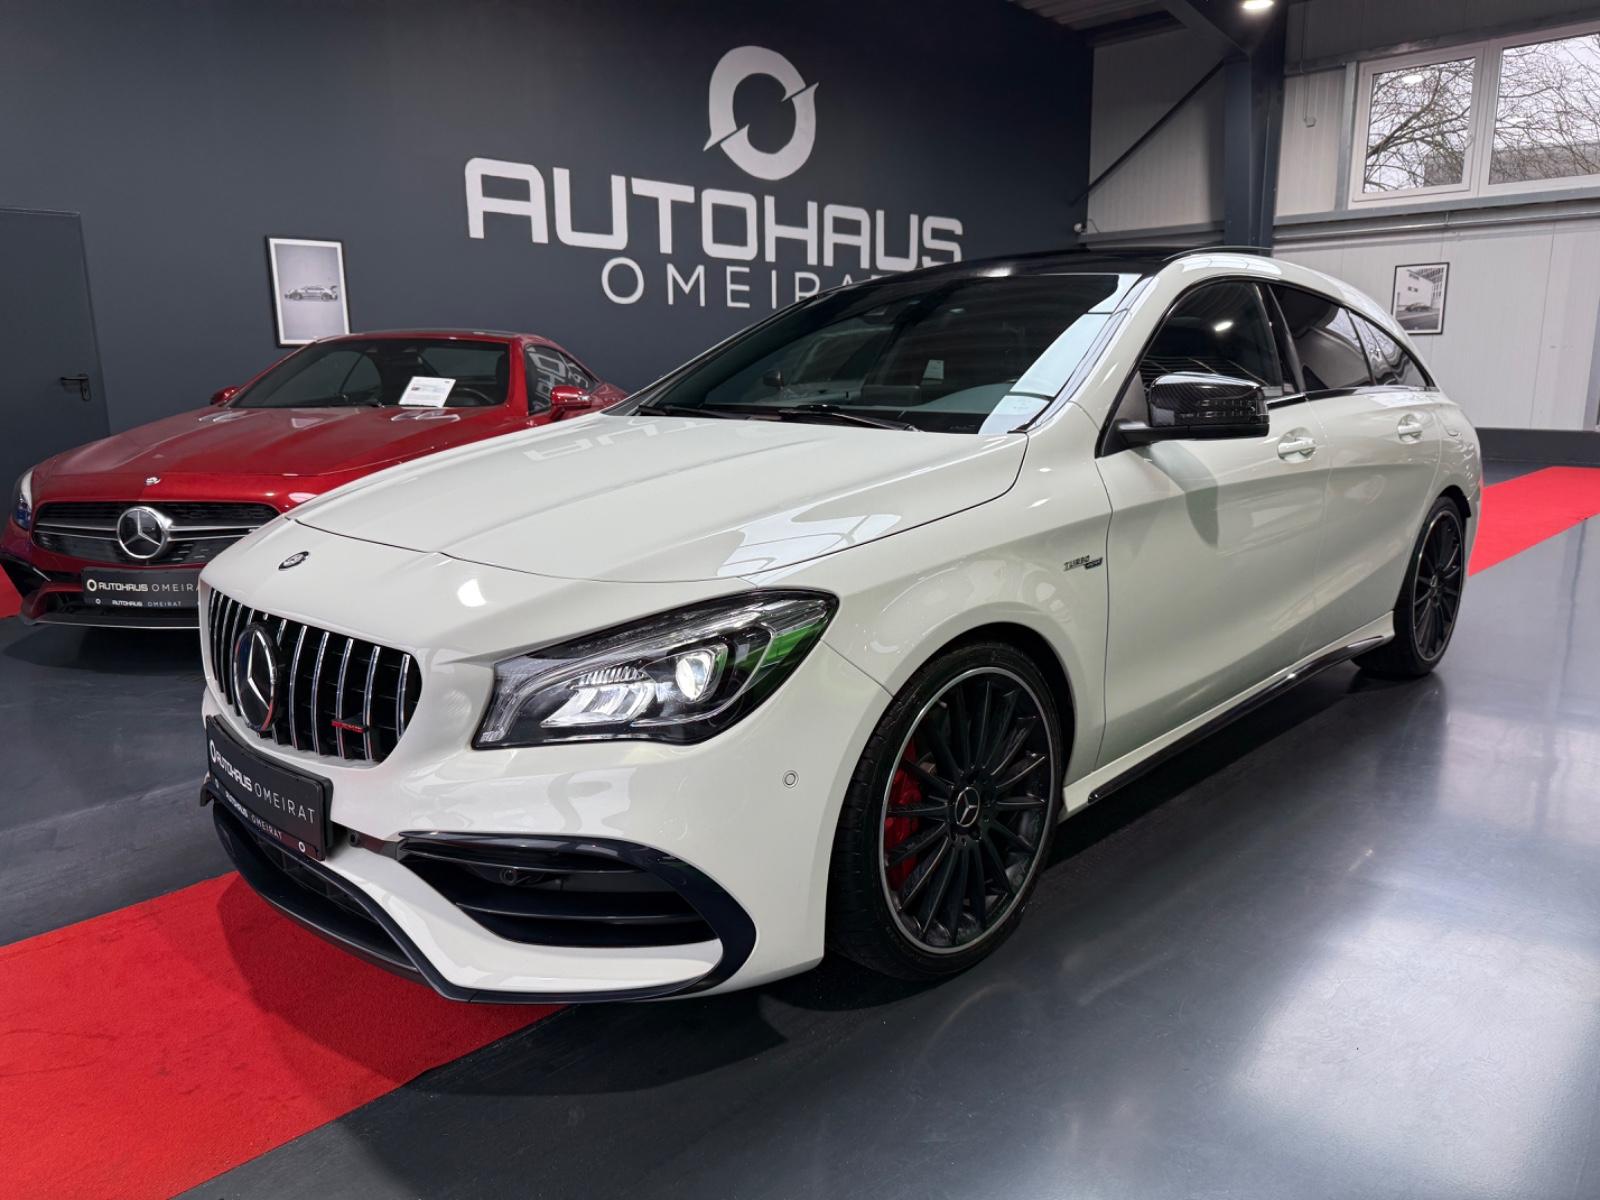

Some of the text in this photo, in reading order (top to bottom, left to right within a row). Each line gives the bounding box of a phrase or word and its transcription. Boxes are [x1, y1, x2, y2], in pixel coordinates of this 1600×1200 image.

[464, 157, 964, 272] AUTOHAUS
[601, 256, 887, 310] OMEIR
[98, 583, 198, 592] AUTOHAUS OMEIR
[215, 750, 315, 824] AUTOHAUS OMEIRAT
[250, 813, 282, 840] OMEIRAT
